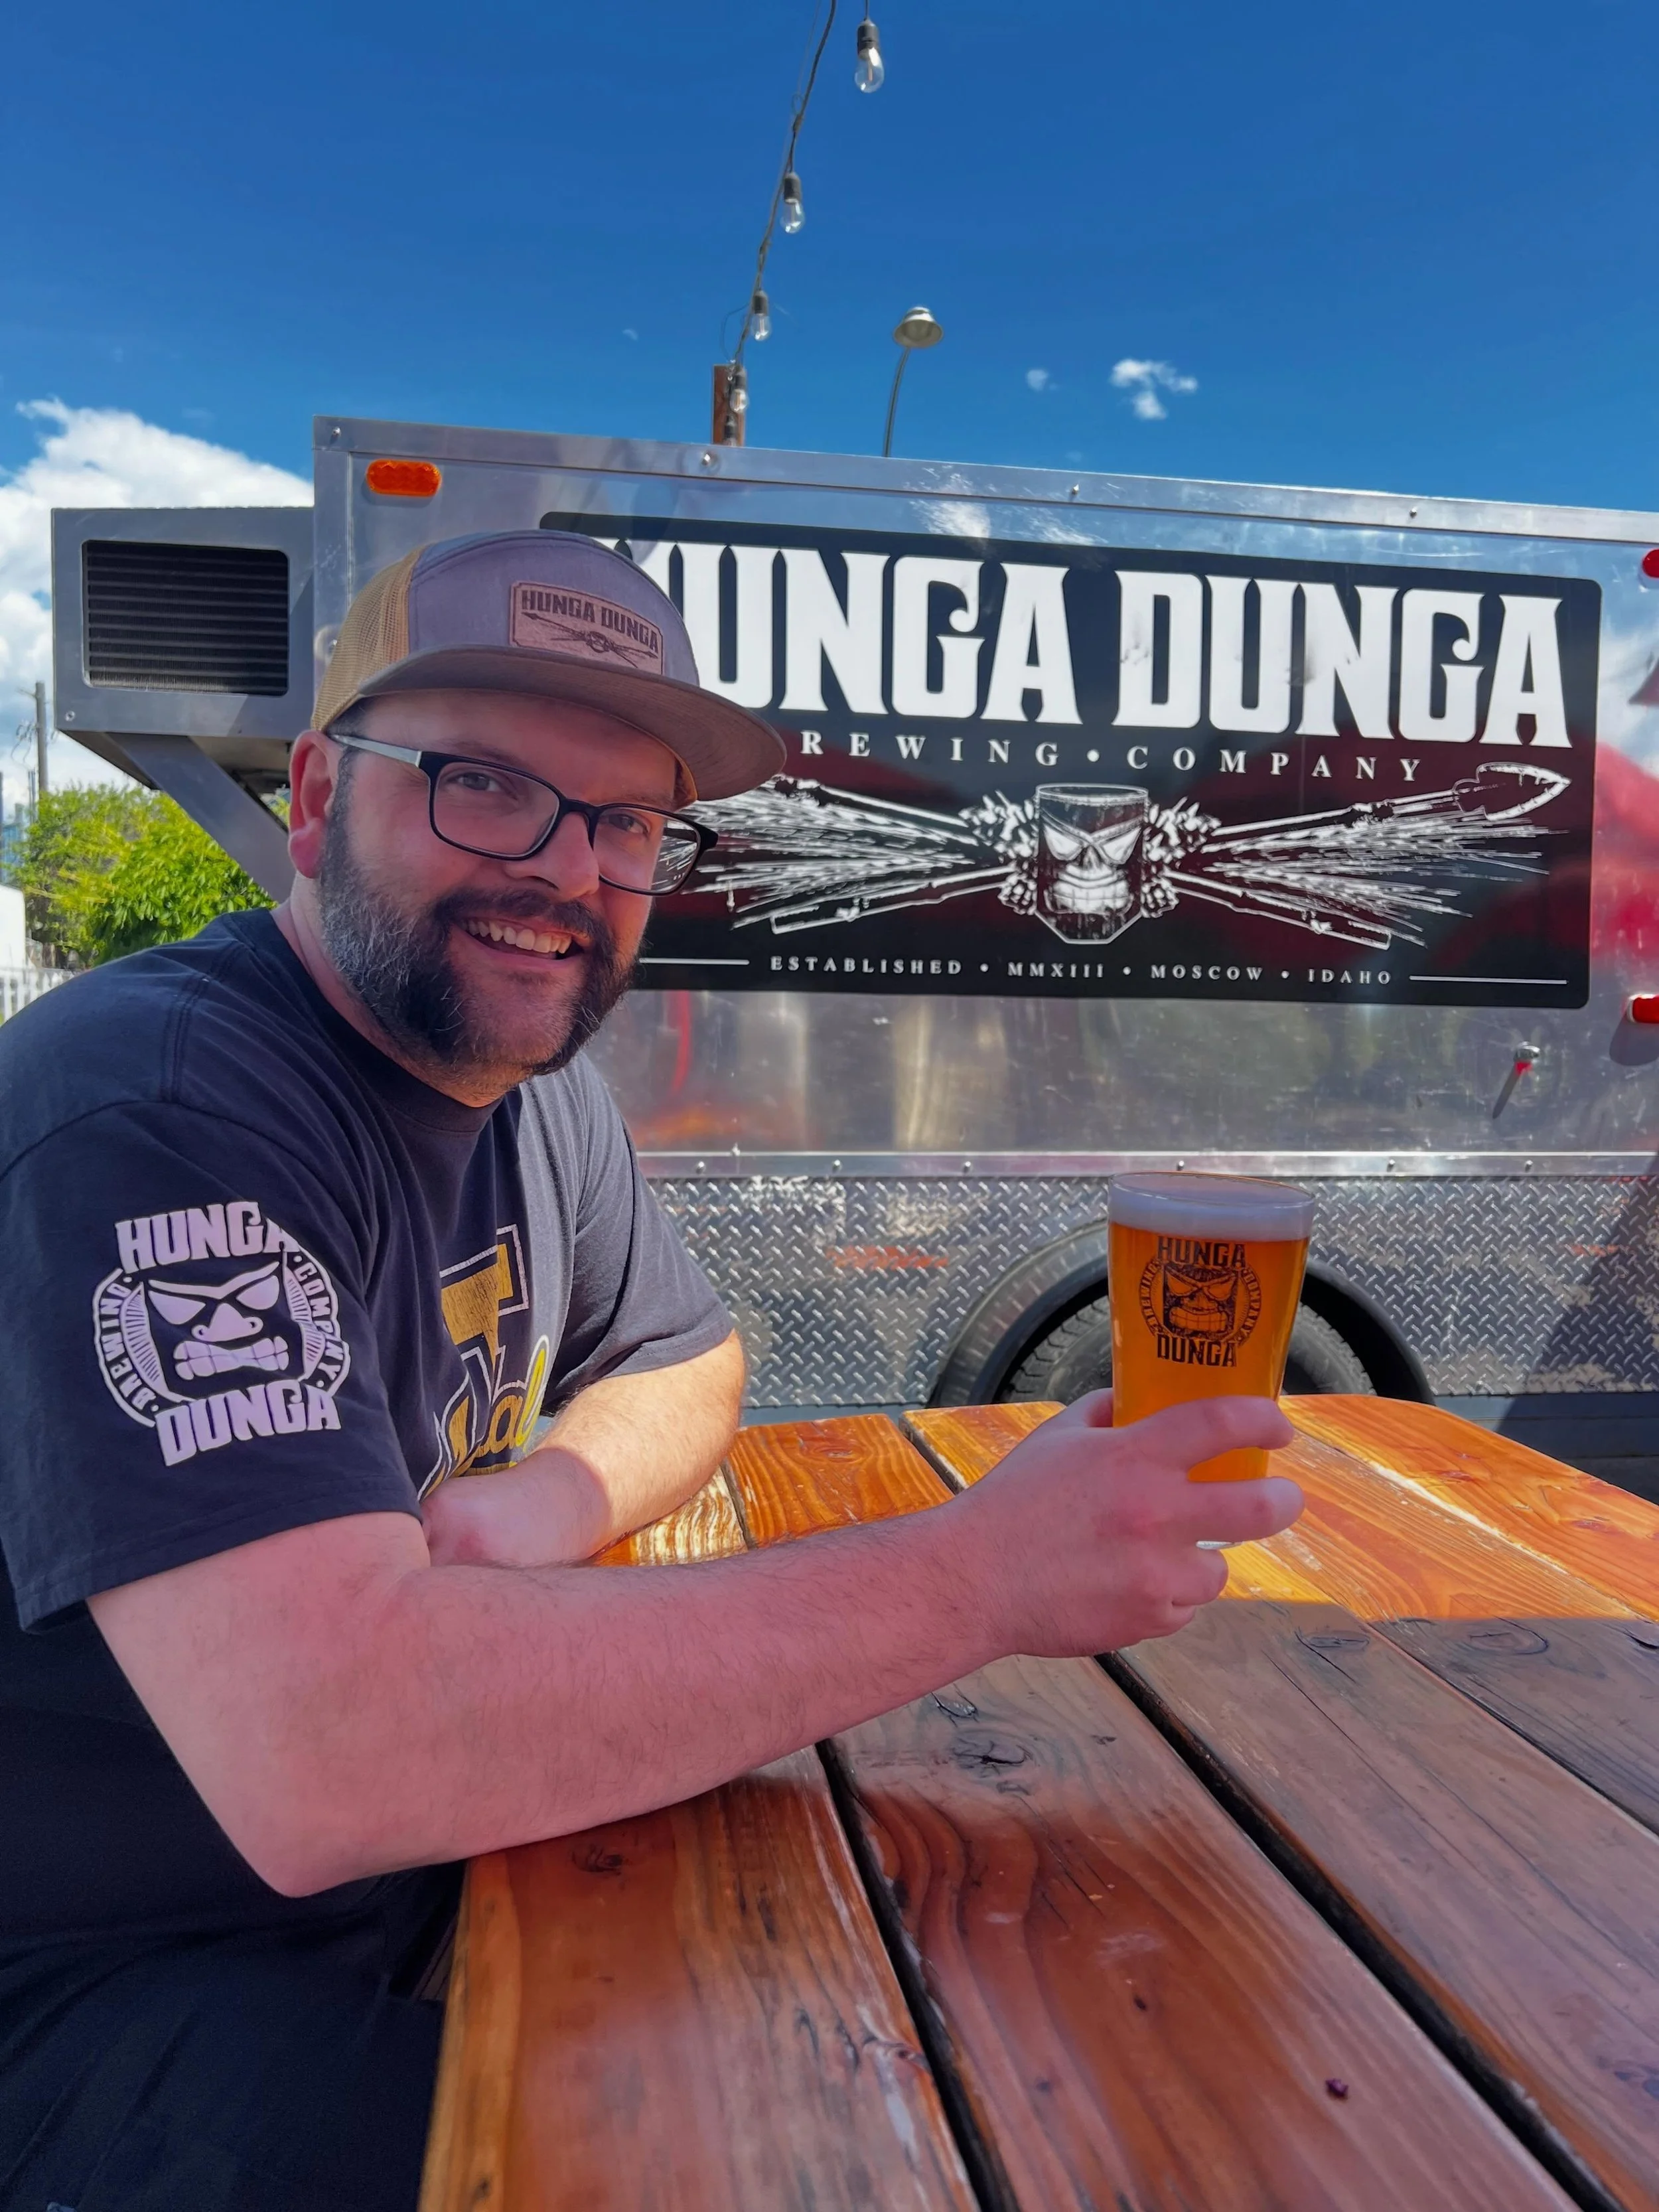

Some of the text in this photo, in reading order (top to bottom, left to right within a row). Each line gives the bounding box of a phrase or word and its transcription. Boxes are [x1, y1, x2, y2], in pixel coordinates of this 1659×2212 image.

[522, 590, 658, 653] HUNGA DUNGA
[593, 536, 1573, 748] UNGA DUNGA
[800, 729, 1420, 781] REWING COMPANY
[770, 956, 1392, 985] ESTABLISHED MMXIII MOSCOW IDAHO
[115, 1201, 300, 1274] HUNGA
[1157, 1236, 1246, 1268] HUNGA
[294, 1262, 344, 1380] COMPNY
[1139, 1262, 1159, 1327] BREWING
[1244, 1272, 1261, 1337] COMPANY
[1157, 1334, 1238, 1367] DUNGA
[154, 1380, 342, 1467] DUNGA
